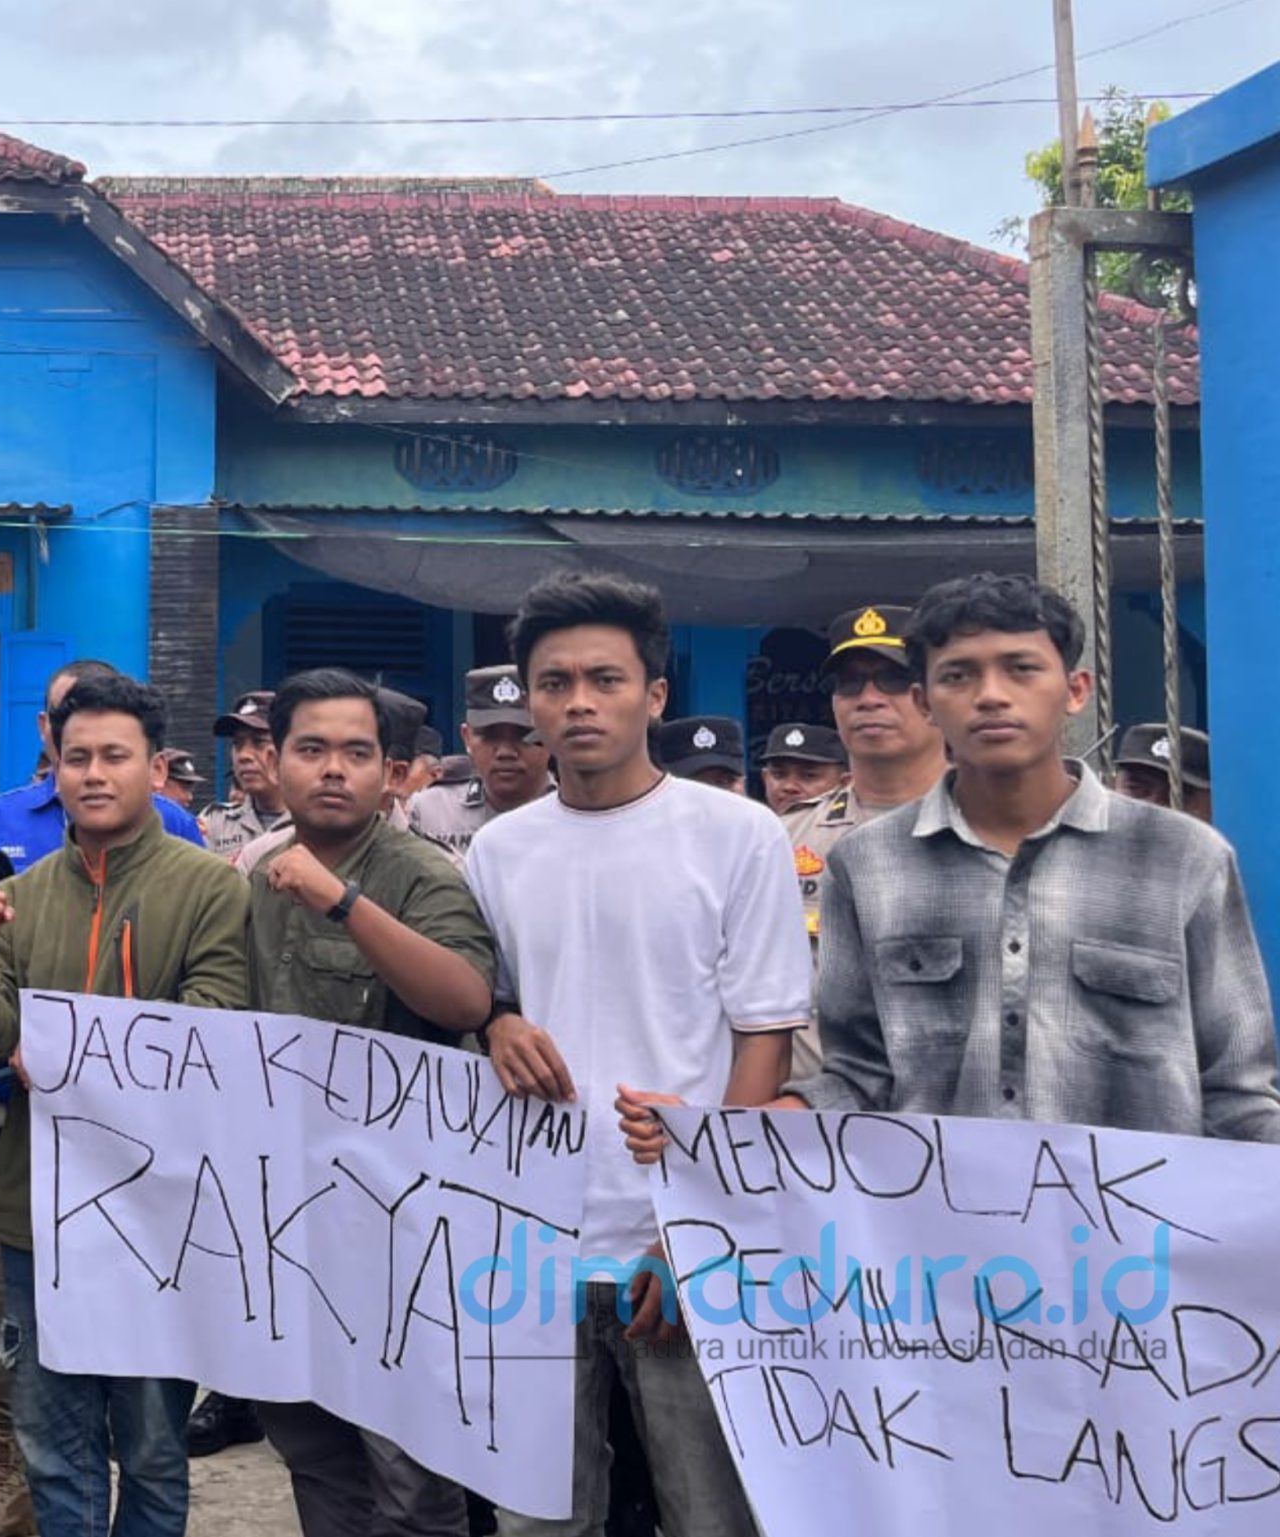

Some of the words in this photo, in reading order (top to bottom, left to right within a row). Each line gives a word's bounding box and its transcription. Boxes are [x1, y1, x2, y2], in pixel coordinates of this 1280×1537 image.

[32, 994, 220, 1092] JAGA
[648, 1104, 1219, 1246] MENOLAK
[51, 1114, 579, 1452] RAKYAT
[708, 1365, 955, 1470] TIDAK
